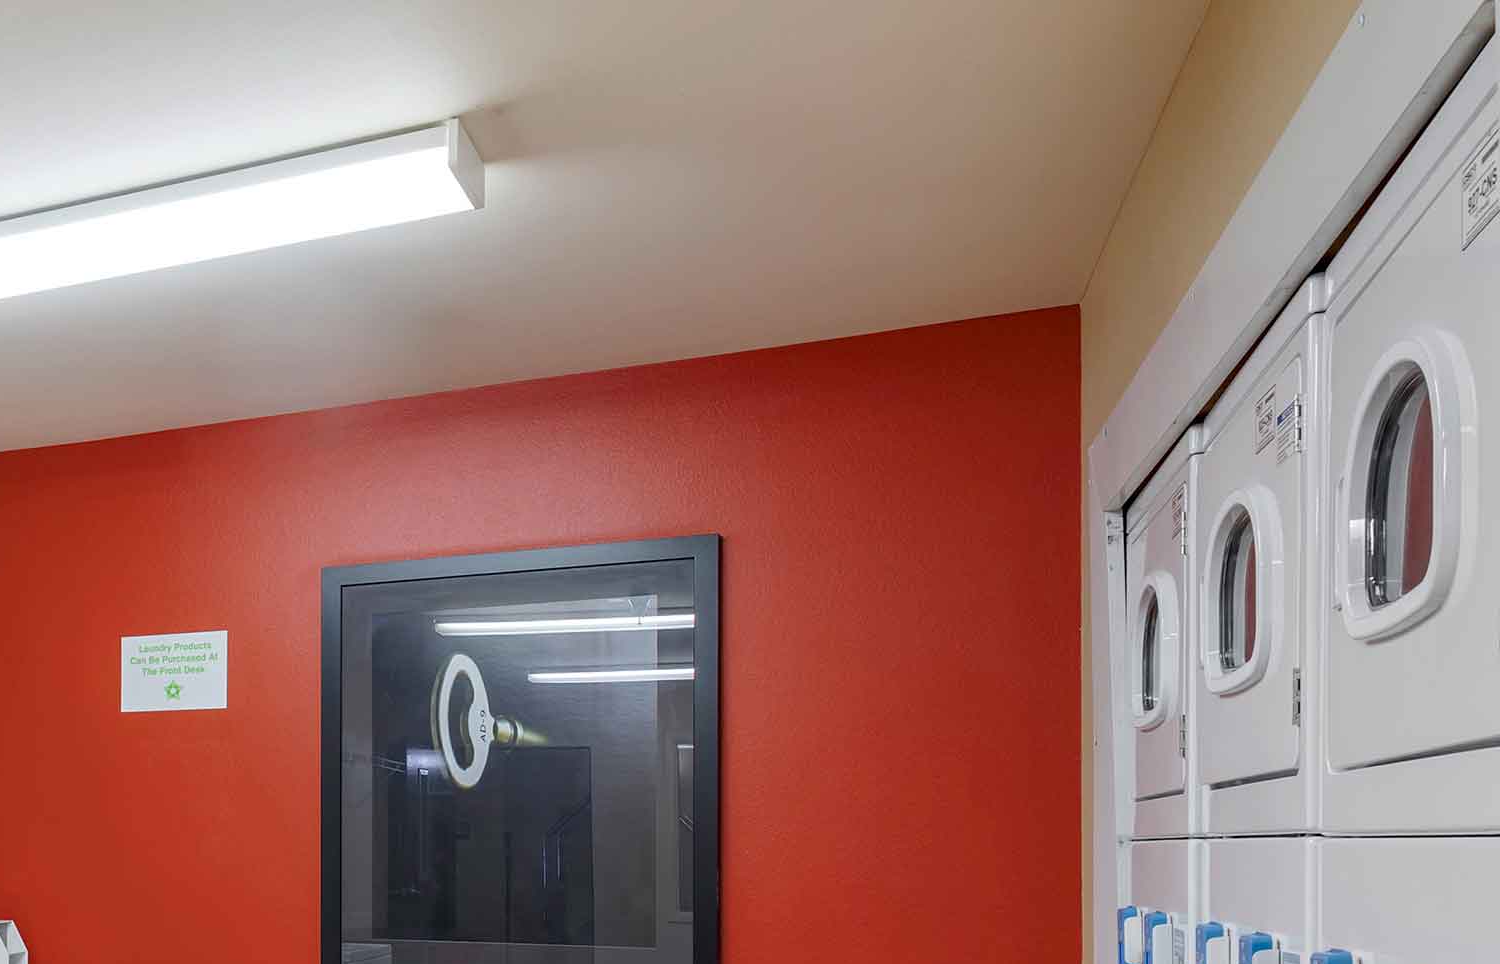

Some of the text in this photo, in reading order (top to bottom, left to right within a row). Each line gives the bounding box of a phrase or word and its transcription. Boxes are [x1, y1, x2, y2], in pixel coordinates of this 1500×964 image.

[138, 642, 212, 654] Laundry Products
[130, 656, 147, 664] Can
[162, 653, 206, 663] Purchased
